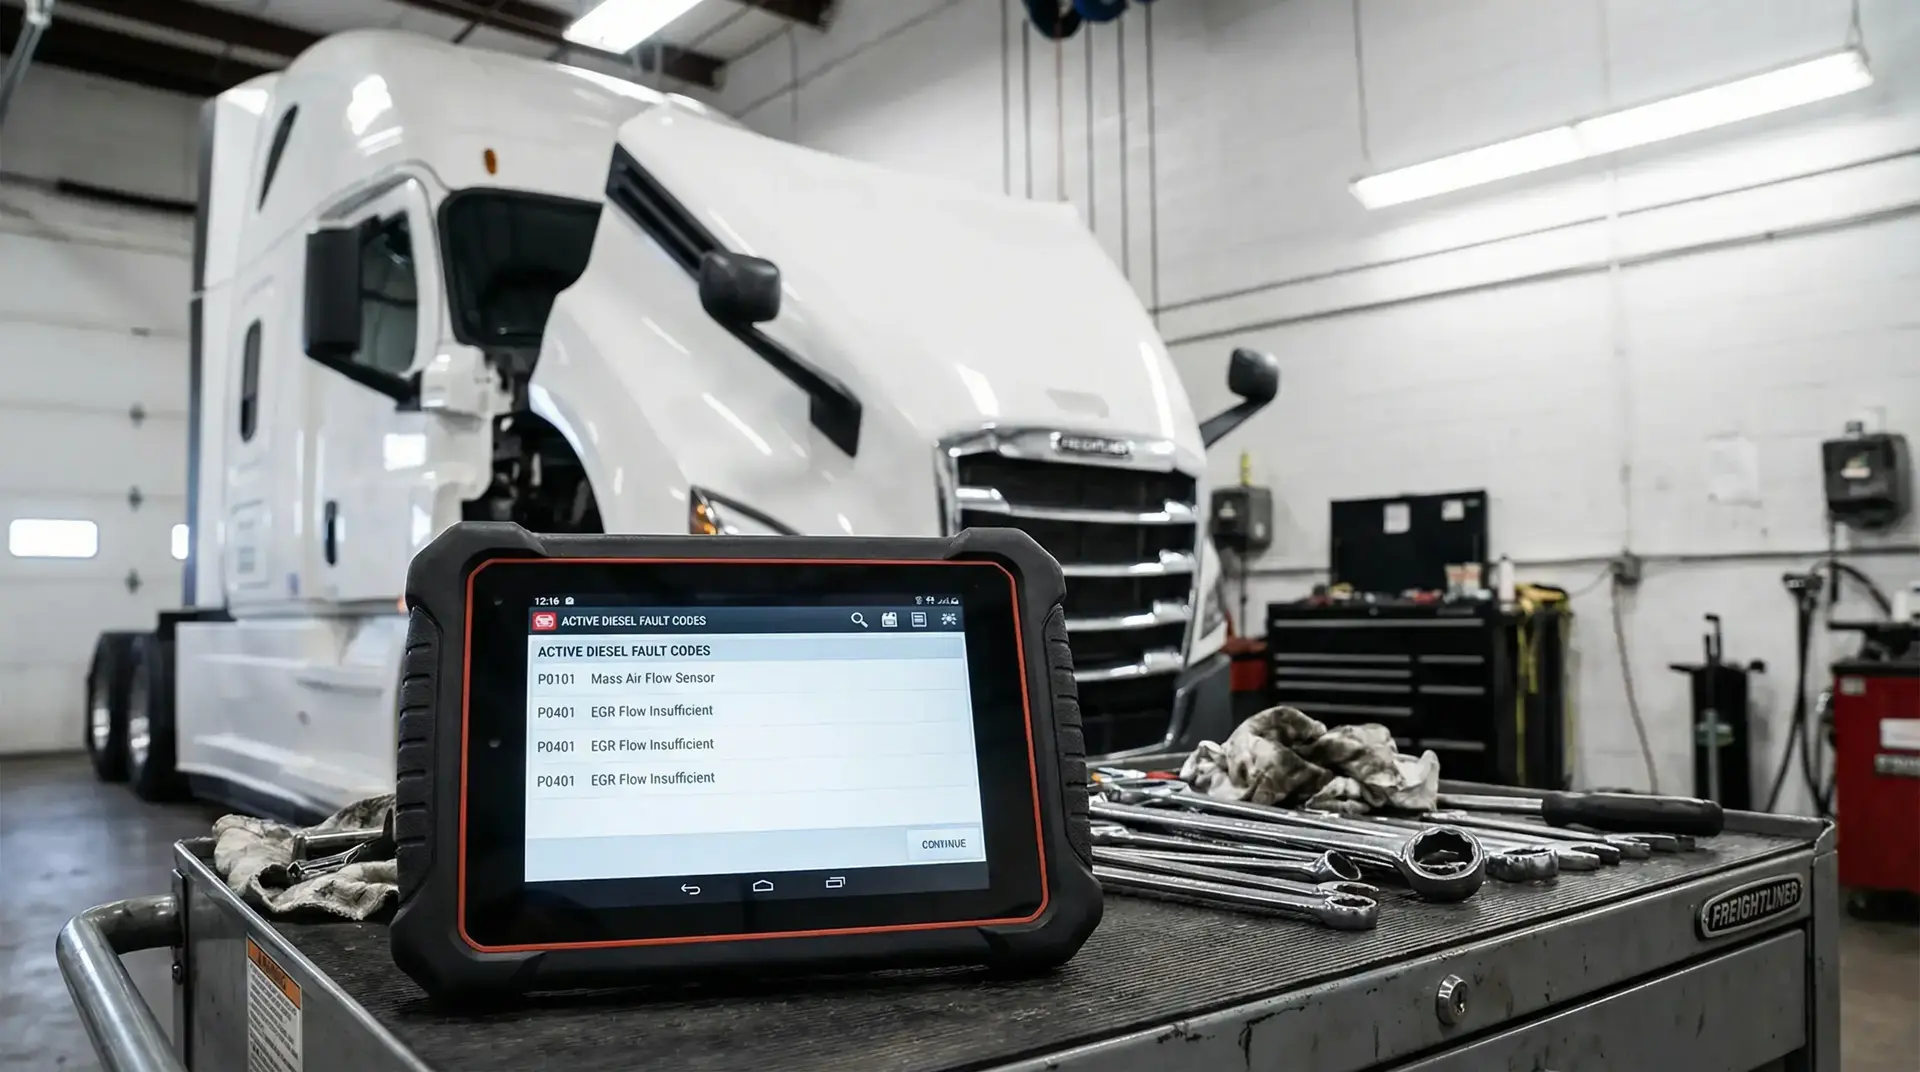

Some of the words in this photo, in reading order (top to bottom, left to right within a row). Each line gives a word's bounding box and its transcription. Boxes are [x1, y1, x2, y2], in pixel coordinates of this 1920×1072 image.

[534, 596, 560, 606] 12:16
[561, 616, 600, 626] ACTIVE
[602, 615, 637, 626] DIESEL
[639, 615, 670, 626] FAULT
[672, 615, 707, 626] CODES
[538, 646, 584, 657] ACTIVE
[586, 645, 629, 657] DIESEL
[631, 645, 668, 656] FAULT
[670, 645, 711, 656] CODES
[537, 673, 575, 685] P0101
[591, 673, 623, 684] Mass
[625, 672, 642, 684] Air
[645, 672, 673, 684] Flow
[675, 671, 716, 683] Sensor
[537, 706, 575, 718] P0401
[591, 706, 616, 718] EGR
[619, 705, 647, 717] Flow
[649, 704, 714, 716] Insufficient
[537, 741, 575, 752] P0401
[591, 740, 616, 751] EGR
[619, 739, 647, 751] Flow
[650, 738, 715, 750] Insufficient
[537, 775, 575, 787] P0401
[591, 774, 616, 786] EGR
[619, 773, 648, 785] Flow
[650, 771, 716, 784] Insufficient
[921, 838, 967, 849] CONTINUE
[1711, 881, 1799, 929] FREIGHTLINER
